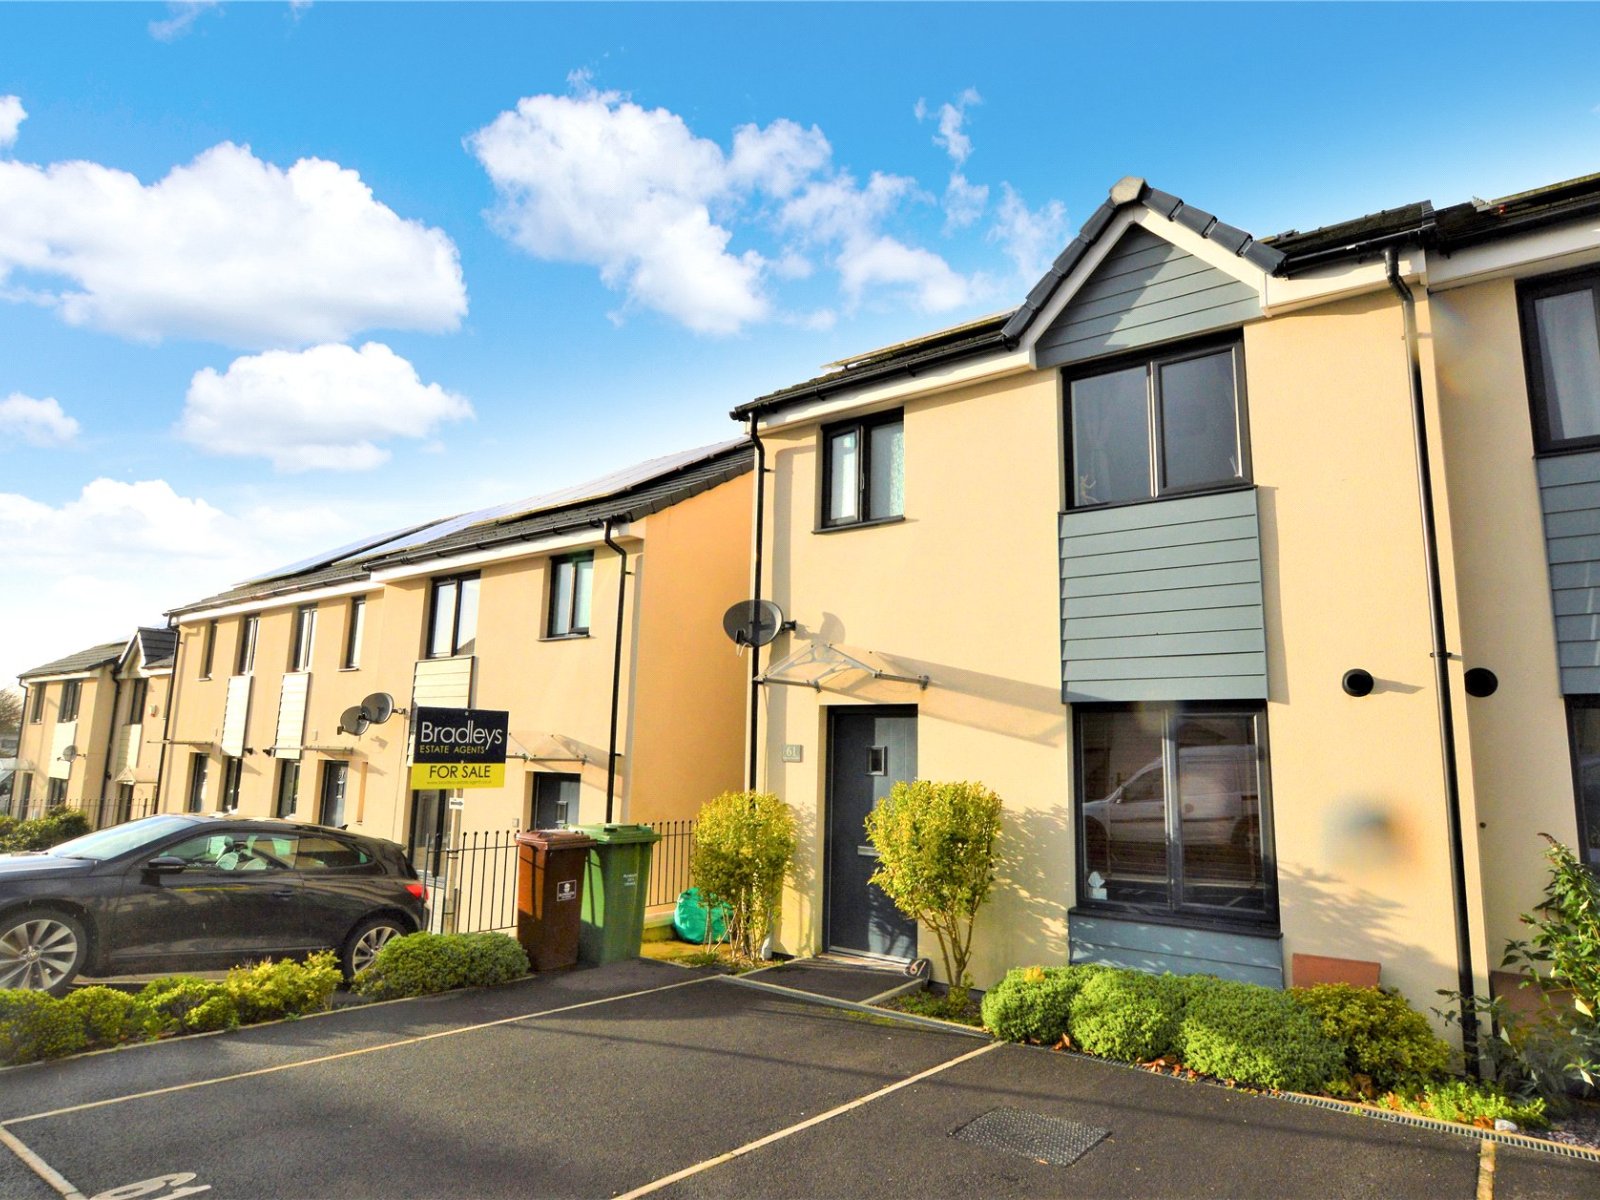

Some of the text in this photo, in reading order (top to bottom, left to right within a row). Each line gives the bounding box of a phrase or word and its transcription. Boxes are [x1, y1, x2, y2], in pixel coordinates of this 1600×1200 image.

[420, 720, 503, 750] Bradleys
[420, 744, 485, 754] ESTATE AGENTS
[786, 745, 796, 757] 61
[429, 765, 491, 779] FOR SALE
